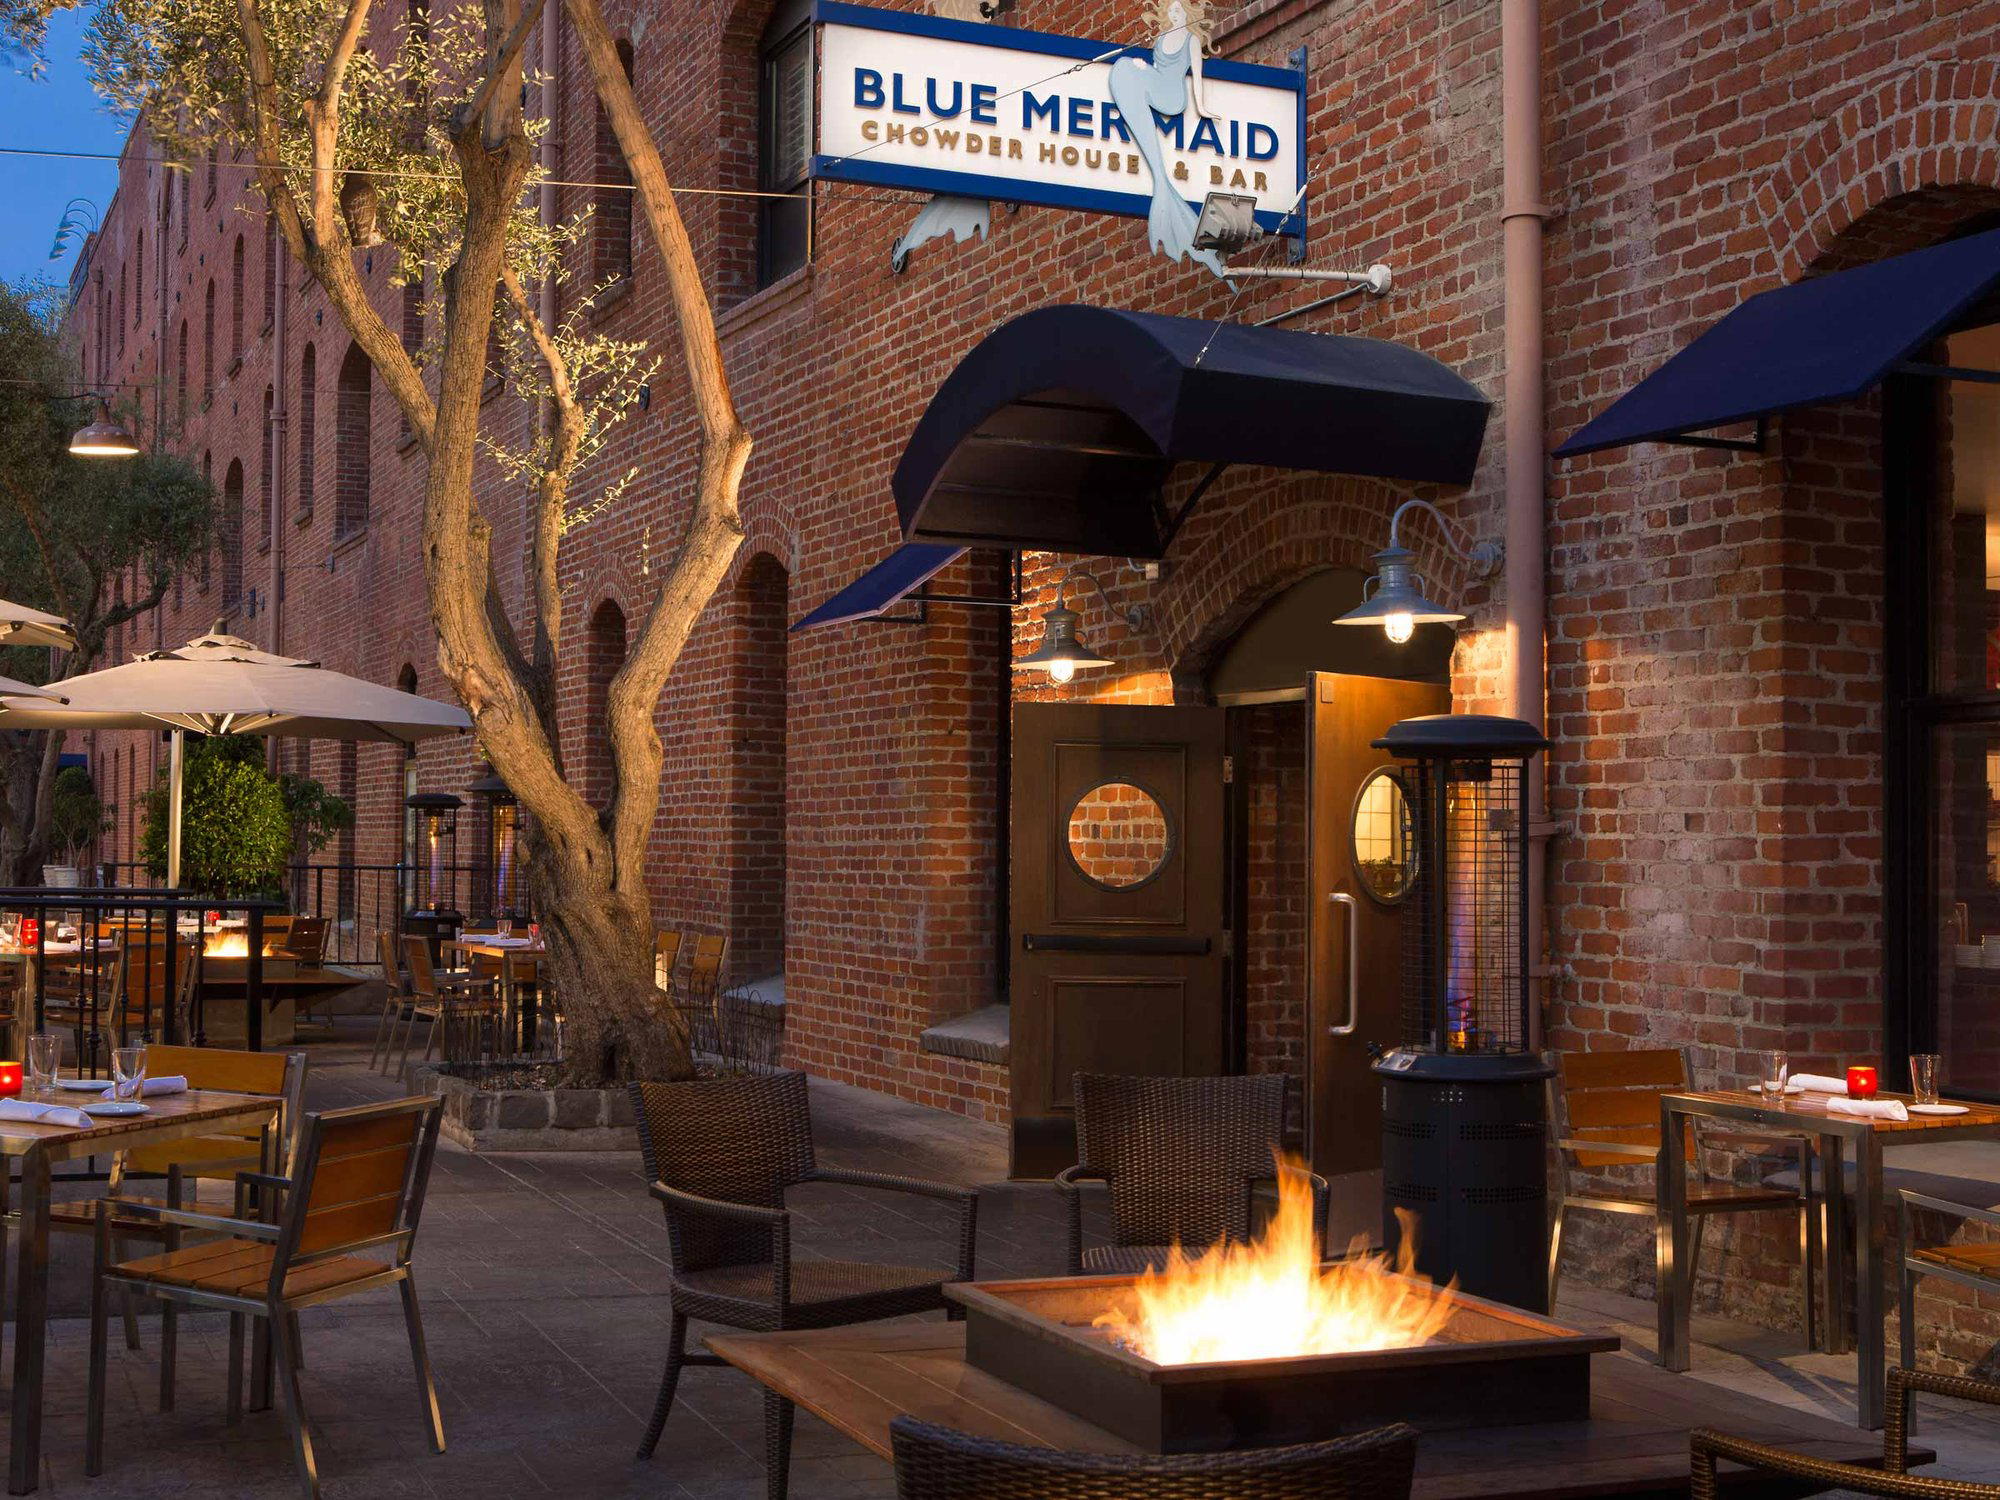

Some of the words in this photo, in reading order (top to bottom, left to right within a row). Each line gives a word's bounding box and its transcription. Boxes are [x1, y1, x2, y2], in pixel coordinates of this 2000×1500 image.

[854, 67, 998, 125] BLUE
[1022, 91, 1279, 161] MERMAID
[861, 120, 1023, 159] CHOWDER
[1039, 143, 1140, 174] HOUSE
[1173, 161, 1189, 181] &
[1210, 165, 1268, 191] BAR
